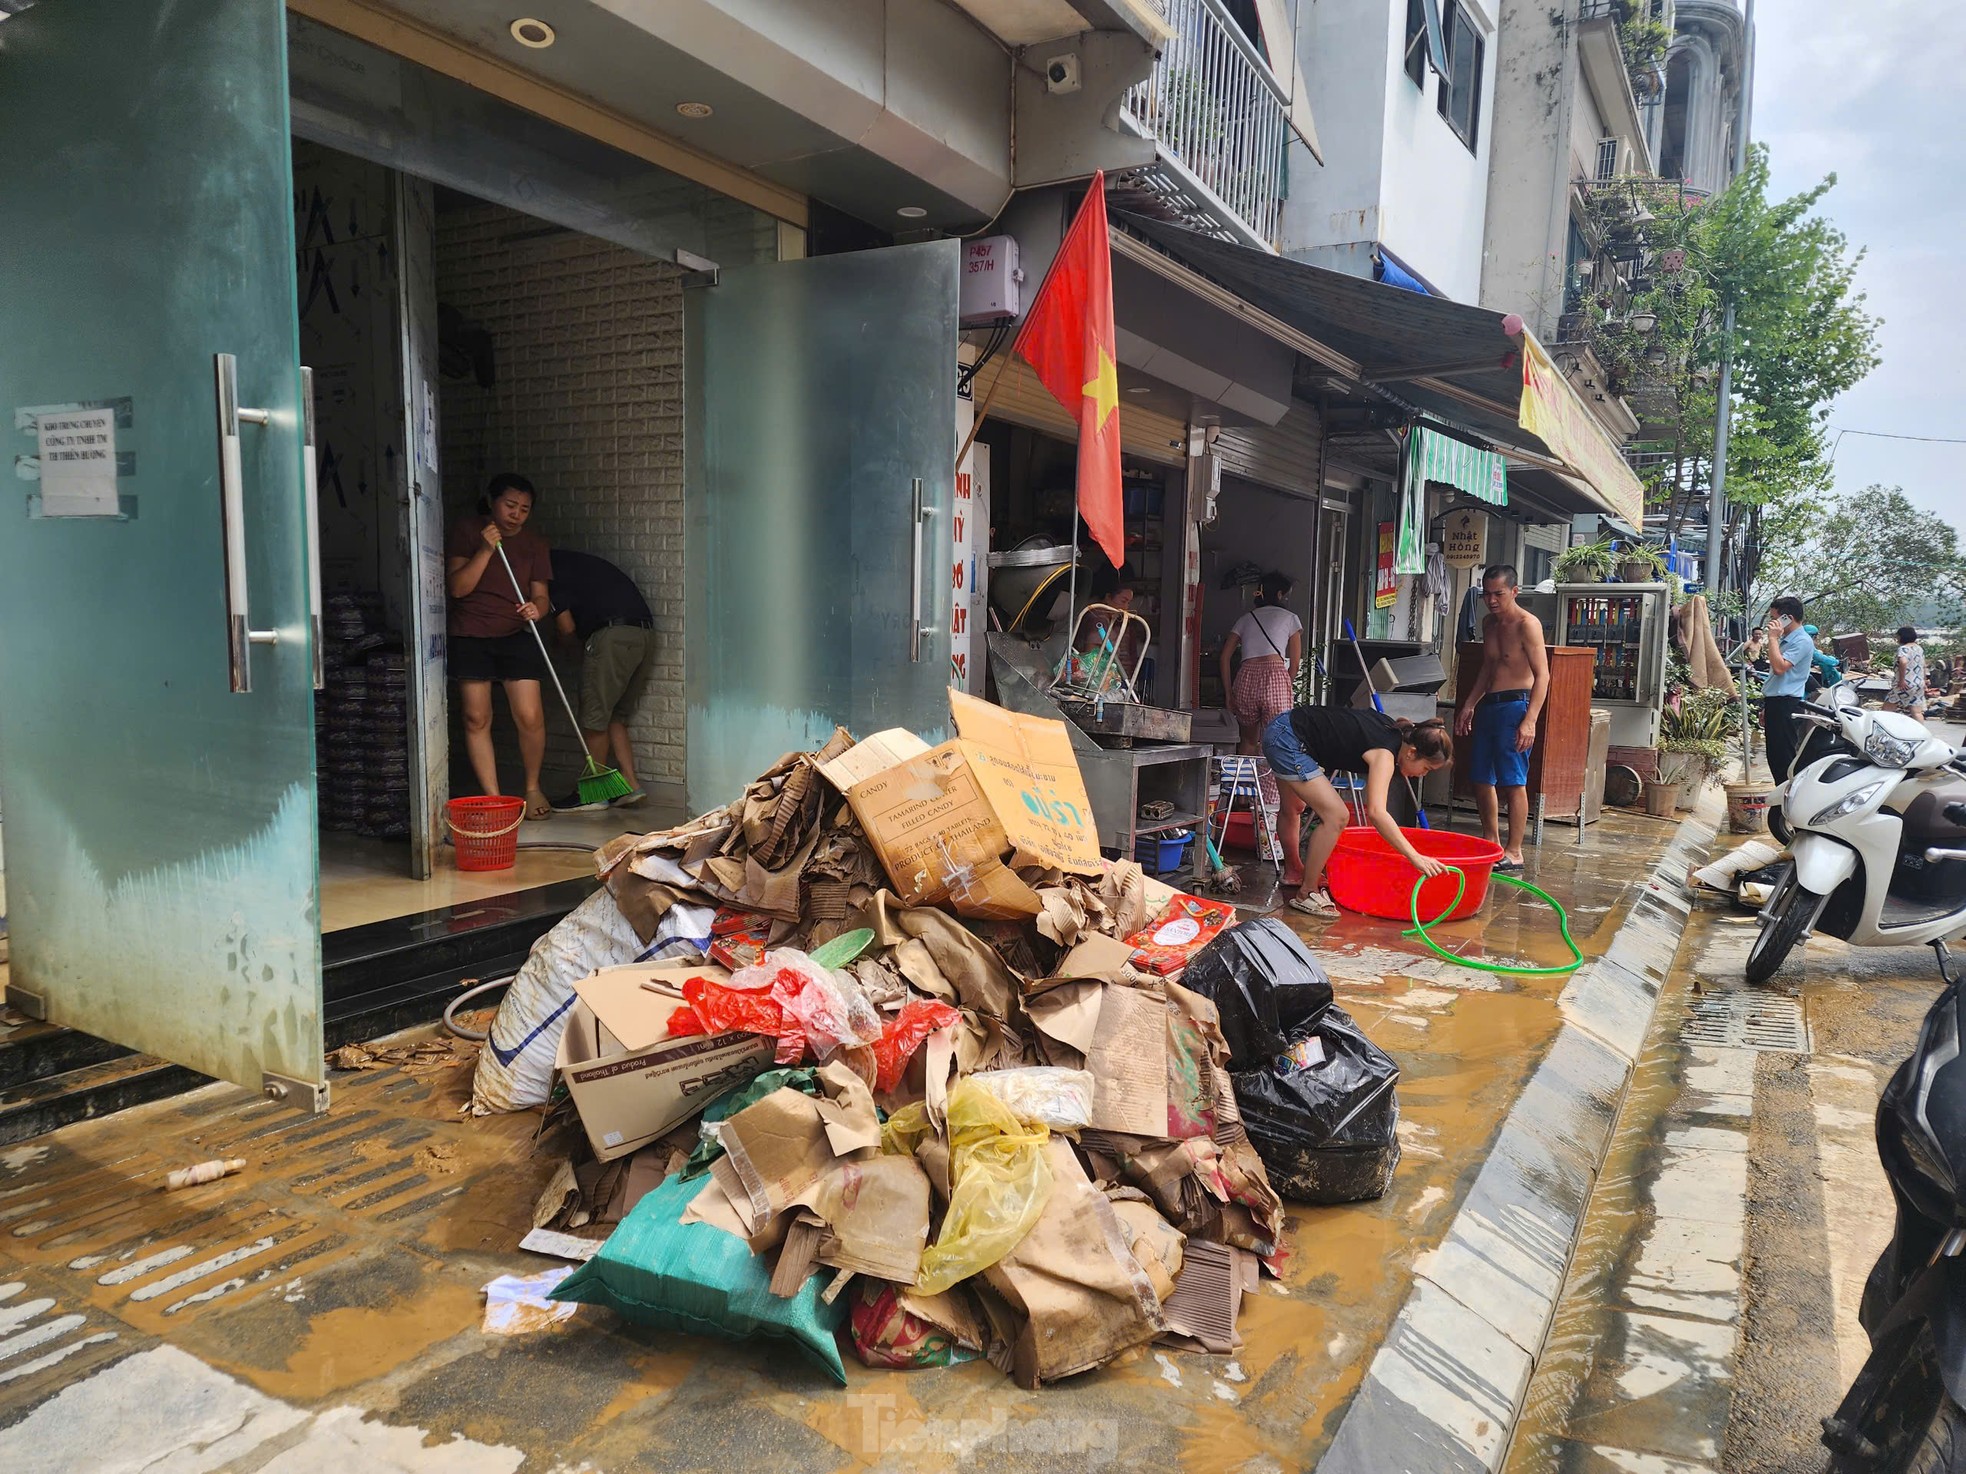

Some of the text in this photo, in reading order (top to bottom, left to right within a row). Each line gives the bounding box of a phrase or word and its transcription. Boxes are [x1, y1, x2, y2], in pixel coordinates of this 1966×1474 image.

[860, 781, 888, 799] CANDY
[888, 800, 928, 823] TAMARIND
[901, 800, 955, 830] FILLED CANDY
[894, 846, 937, 871] PRODUCT
[950, 817, 991, 842] THAILAND
[580, 1067, 609, 1081] Thailand
[623, 1059, 647, 1071] Product
